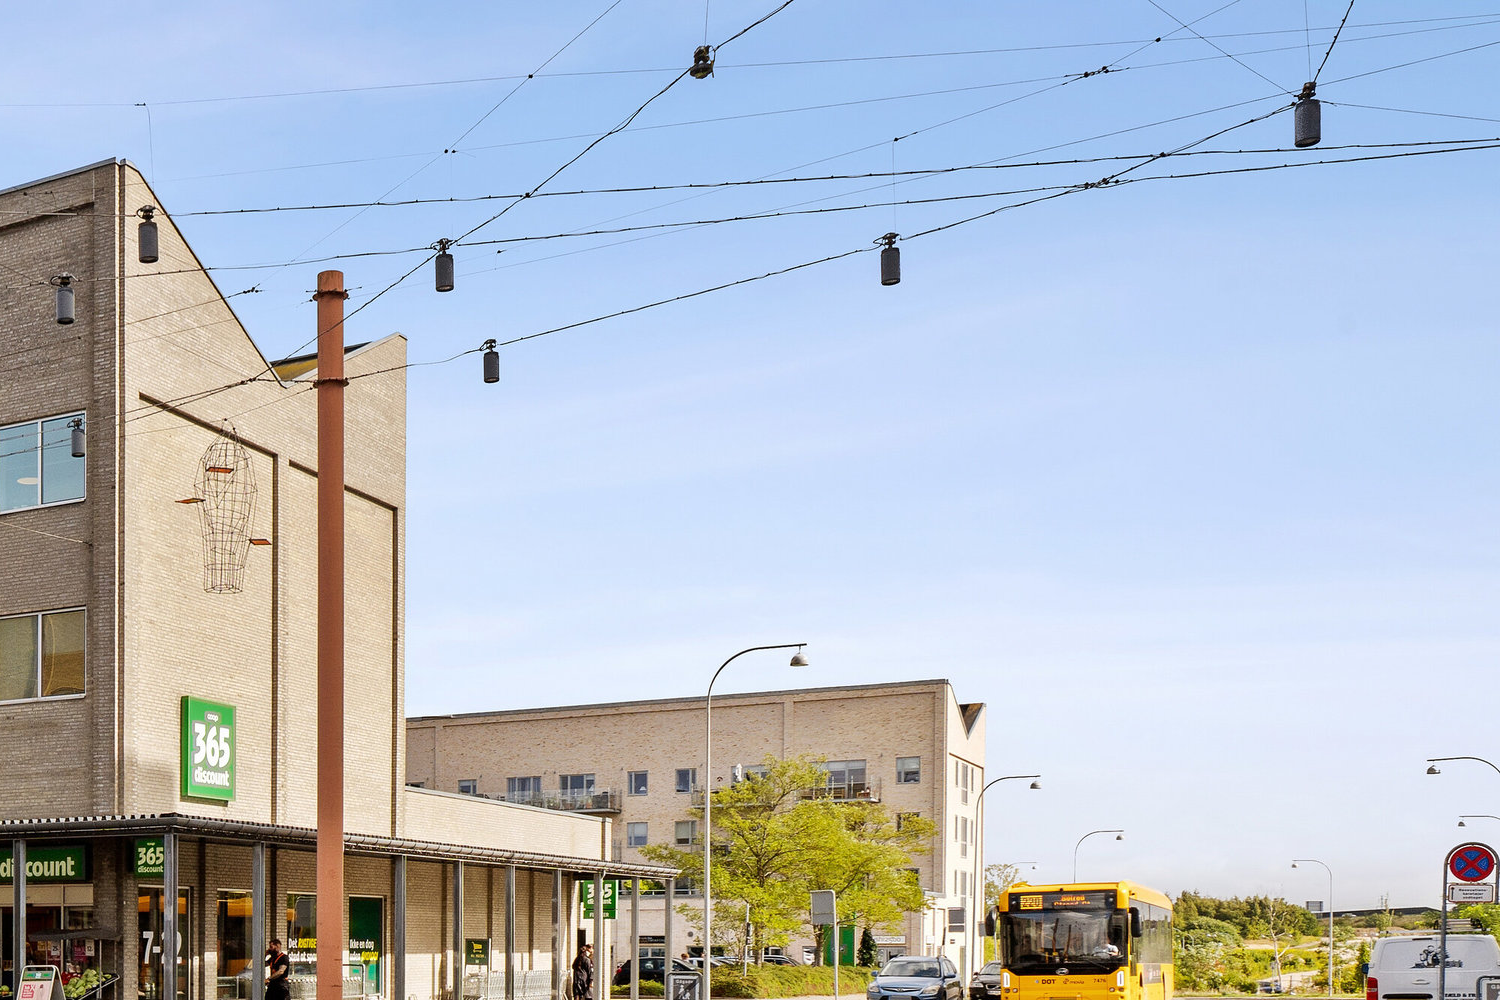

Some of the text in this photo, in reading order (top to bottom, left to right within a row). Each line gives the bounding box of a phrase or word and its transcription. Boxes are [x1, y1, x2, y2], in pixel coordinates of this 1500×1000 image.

[194, 722, 231, 768] 365
[194, 766, 230, 787] discount
[137, 847, 164, 865] 365
[0, 856, 75, 878] dicount
[137, 865, 164, 873] discount
[587, 883, 612, 898] 35
[288, 937, 298, 949] Det
